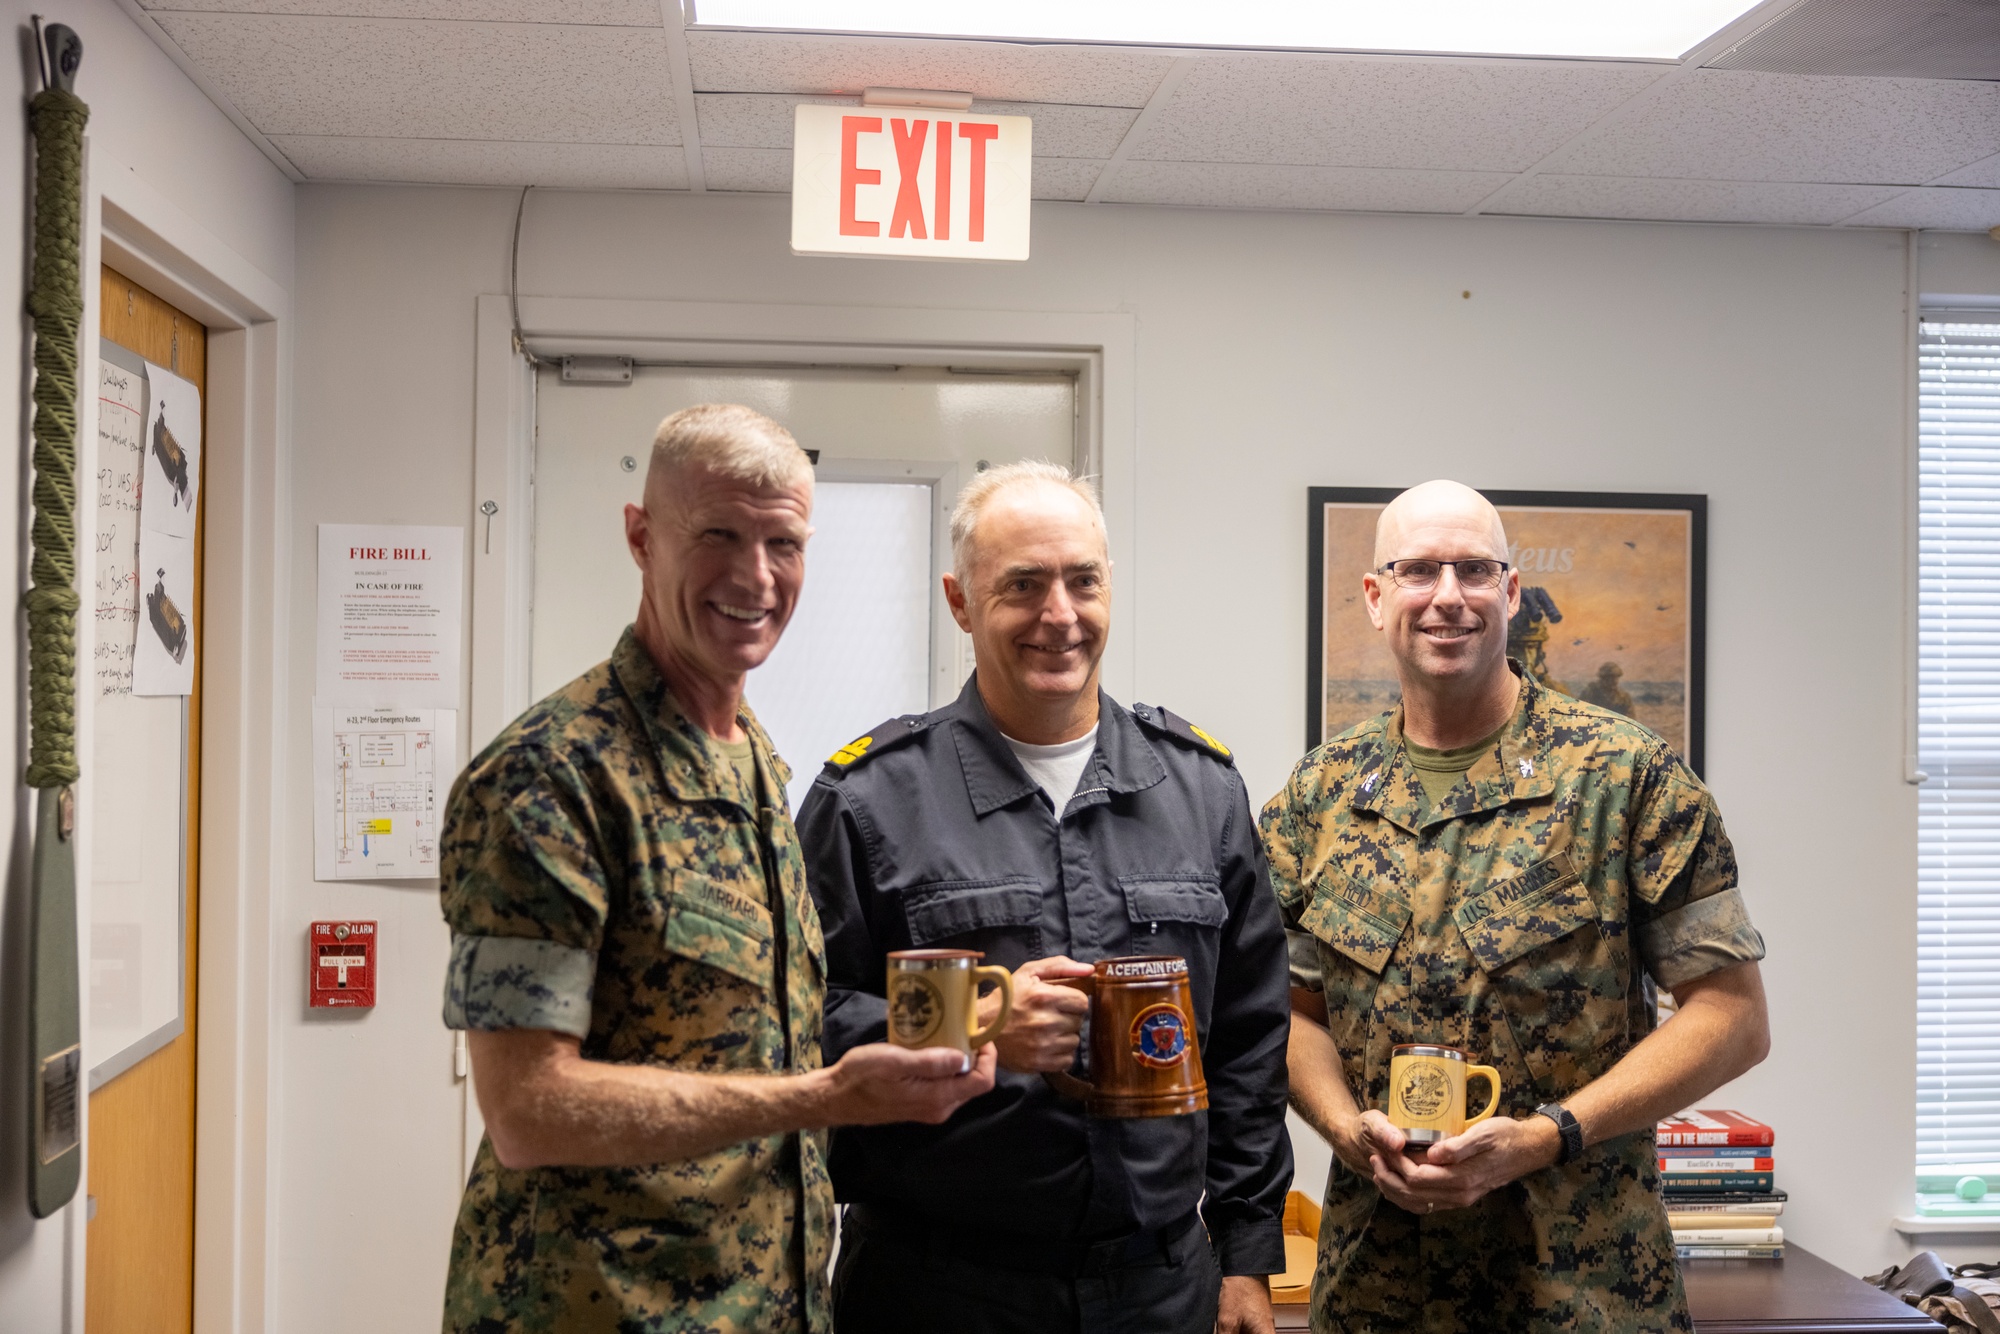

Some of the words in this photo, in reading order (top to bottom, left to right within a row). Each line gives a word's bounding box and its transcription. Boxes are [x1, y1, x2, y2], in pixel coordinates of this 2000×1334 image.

[840, 115, 998, 243] EXIT
[350, 547, 388, 560] FIRE
[393, 548, 431, 560] BILL
[366, 583, 390, 591] CASE
[380, 716, 404, 725] Emergency
[405, 715, 421, 724] Routes
[1495, 861, 1561, 907] MARINES
[1342, 880, 1373, 908] REID
[700, 882, 759, 922] JARRARD
[316, 924, 331, 935] FIRE
[351, 924, 374, 935] ALARM
[1106, 964, 1114, 975] A
[1115, 961, 1165, 976] CERTAIN
[1672, 1132, 1682, 1145] IN
[1682, 1132, 1696, 1145] THE
[1696, 1132, 1729, 1145] MACHINE
[1687, 1160, 1715, 1168] Euclid's
[1716, 1161, 1735, 1169] Army
